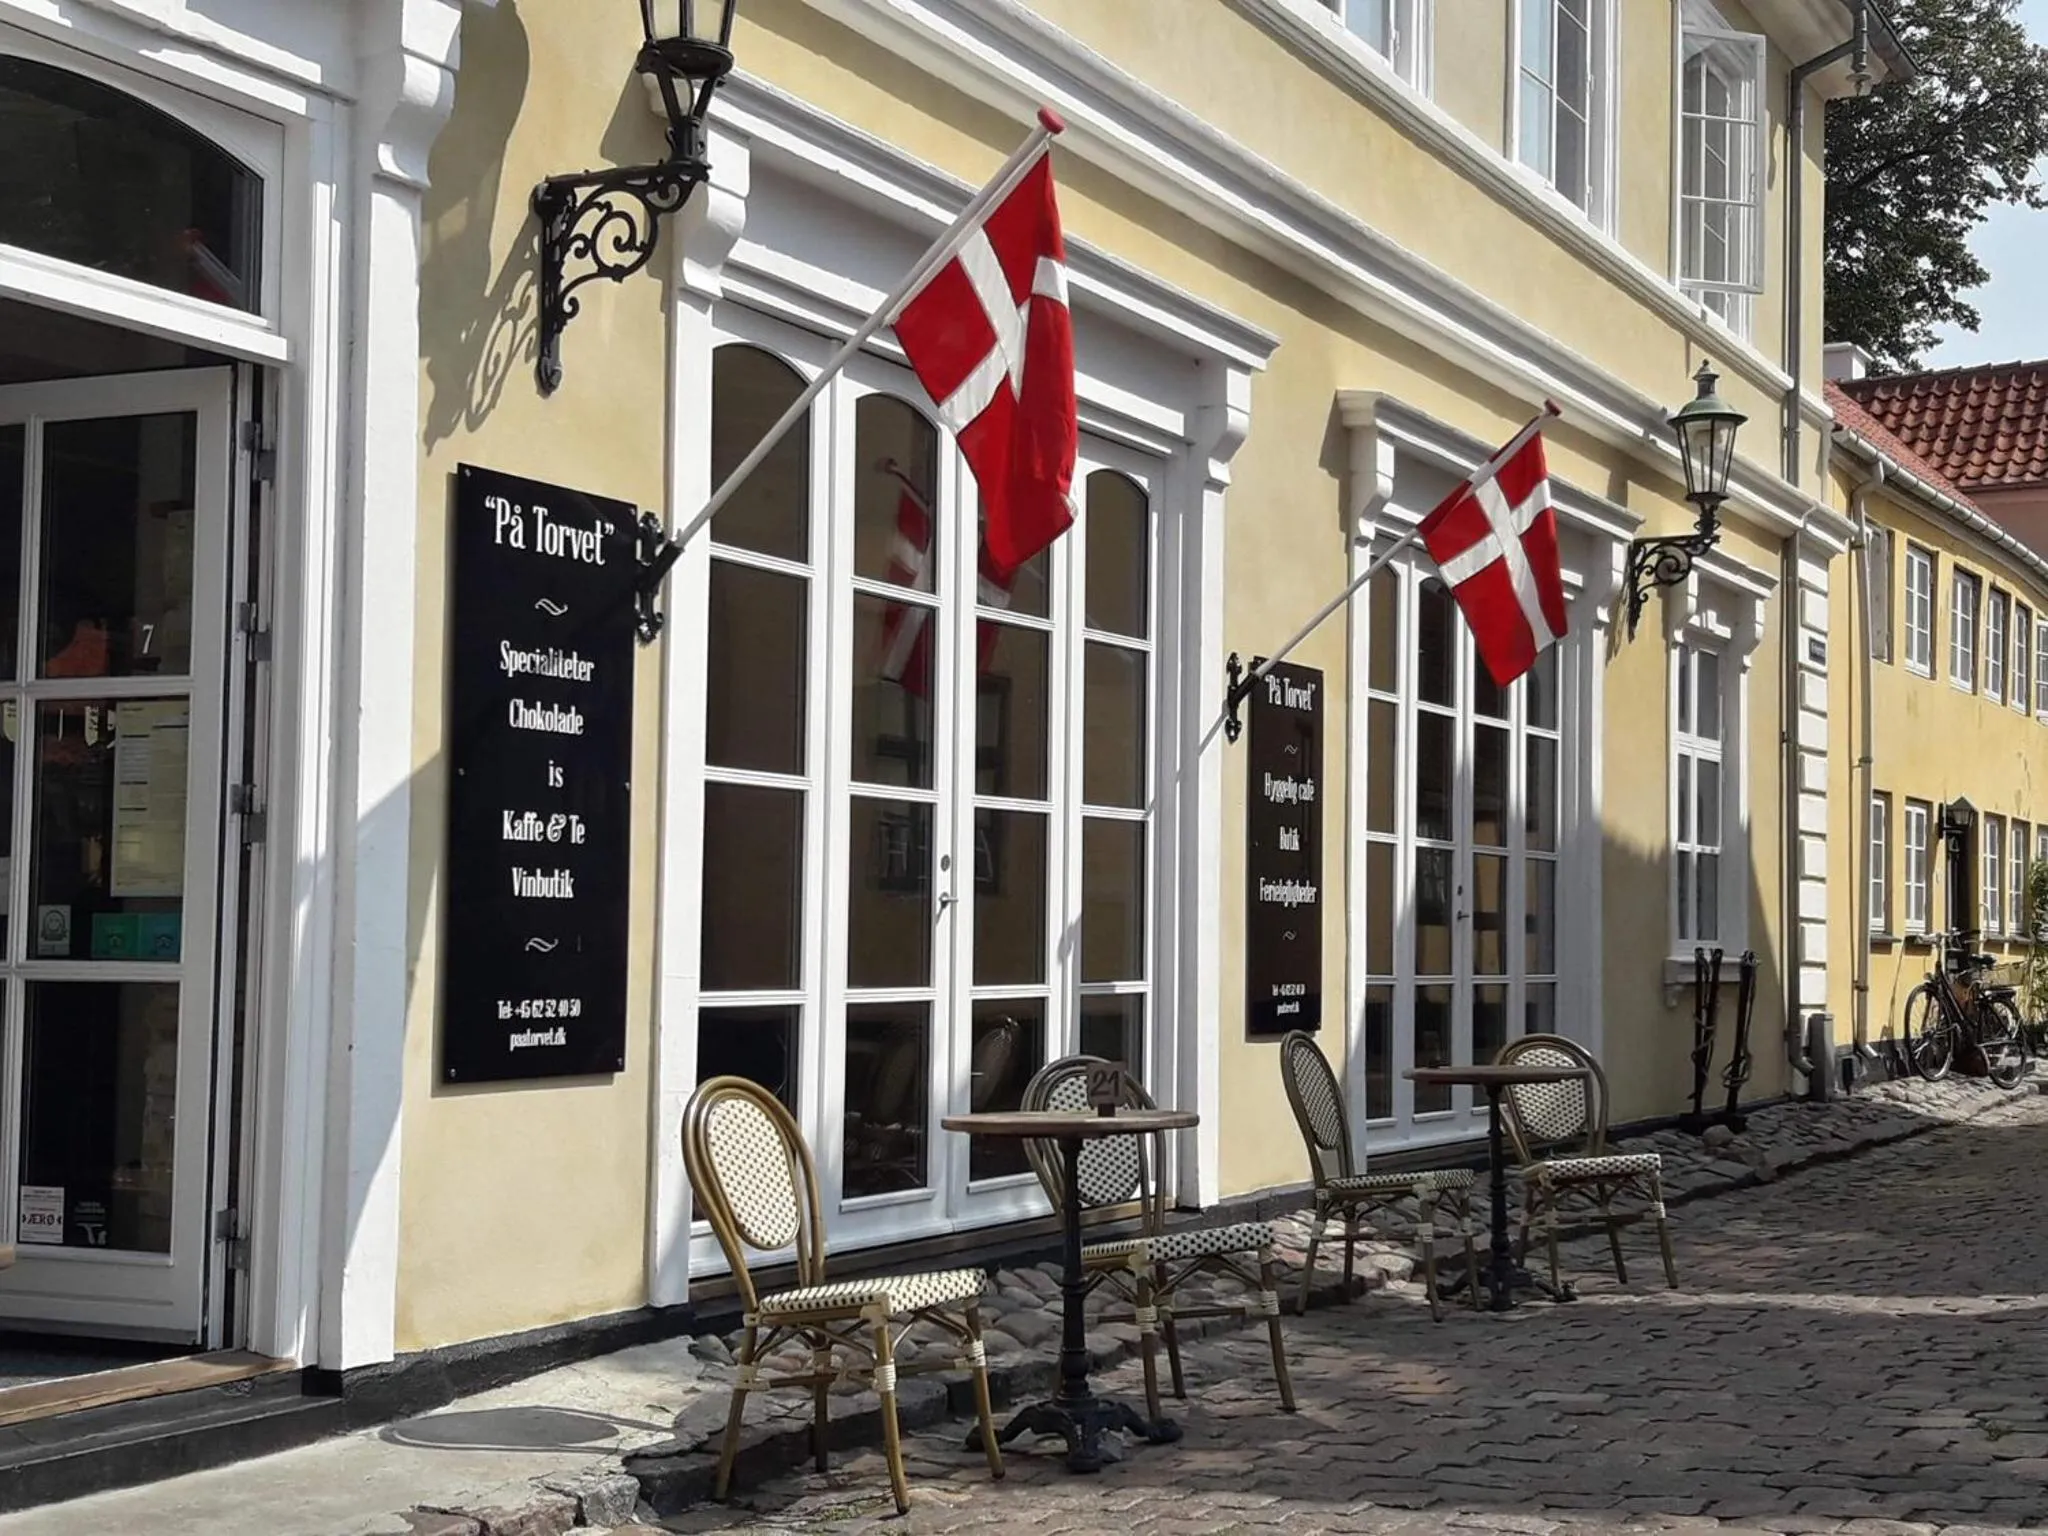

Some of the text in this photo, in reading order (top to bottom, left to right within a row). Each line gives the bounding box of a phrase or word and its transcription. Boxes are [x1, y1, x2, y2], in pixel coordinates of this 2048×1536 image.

[142, 624, 154, 654] 7
[500, 640, 595, 682] Specialiteter
[508, 698, 584, 736] Chokolade
[548, 759, 564, 788] is
[1264, 771, 1298, 805] Hyggelig
[502, 809, 586, 845] Kaffe & Te
[1279, 826, 1300, 851] Butik
[511, 866, 575, 899] Vinbutik
[1090, 1070, 1120, 1098] 21
